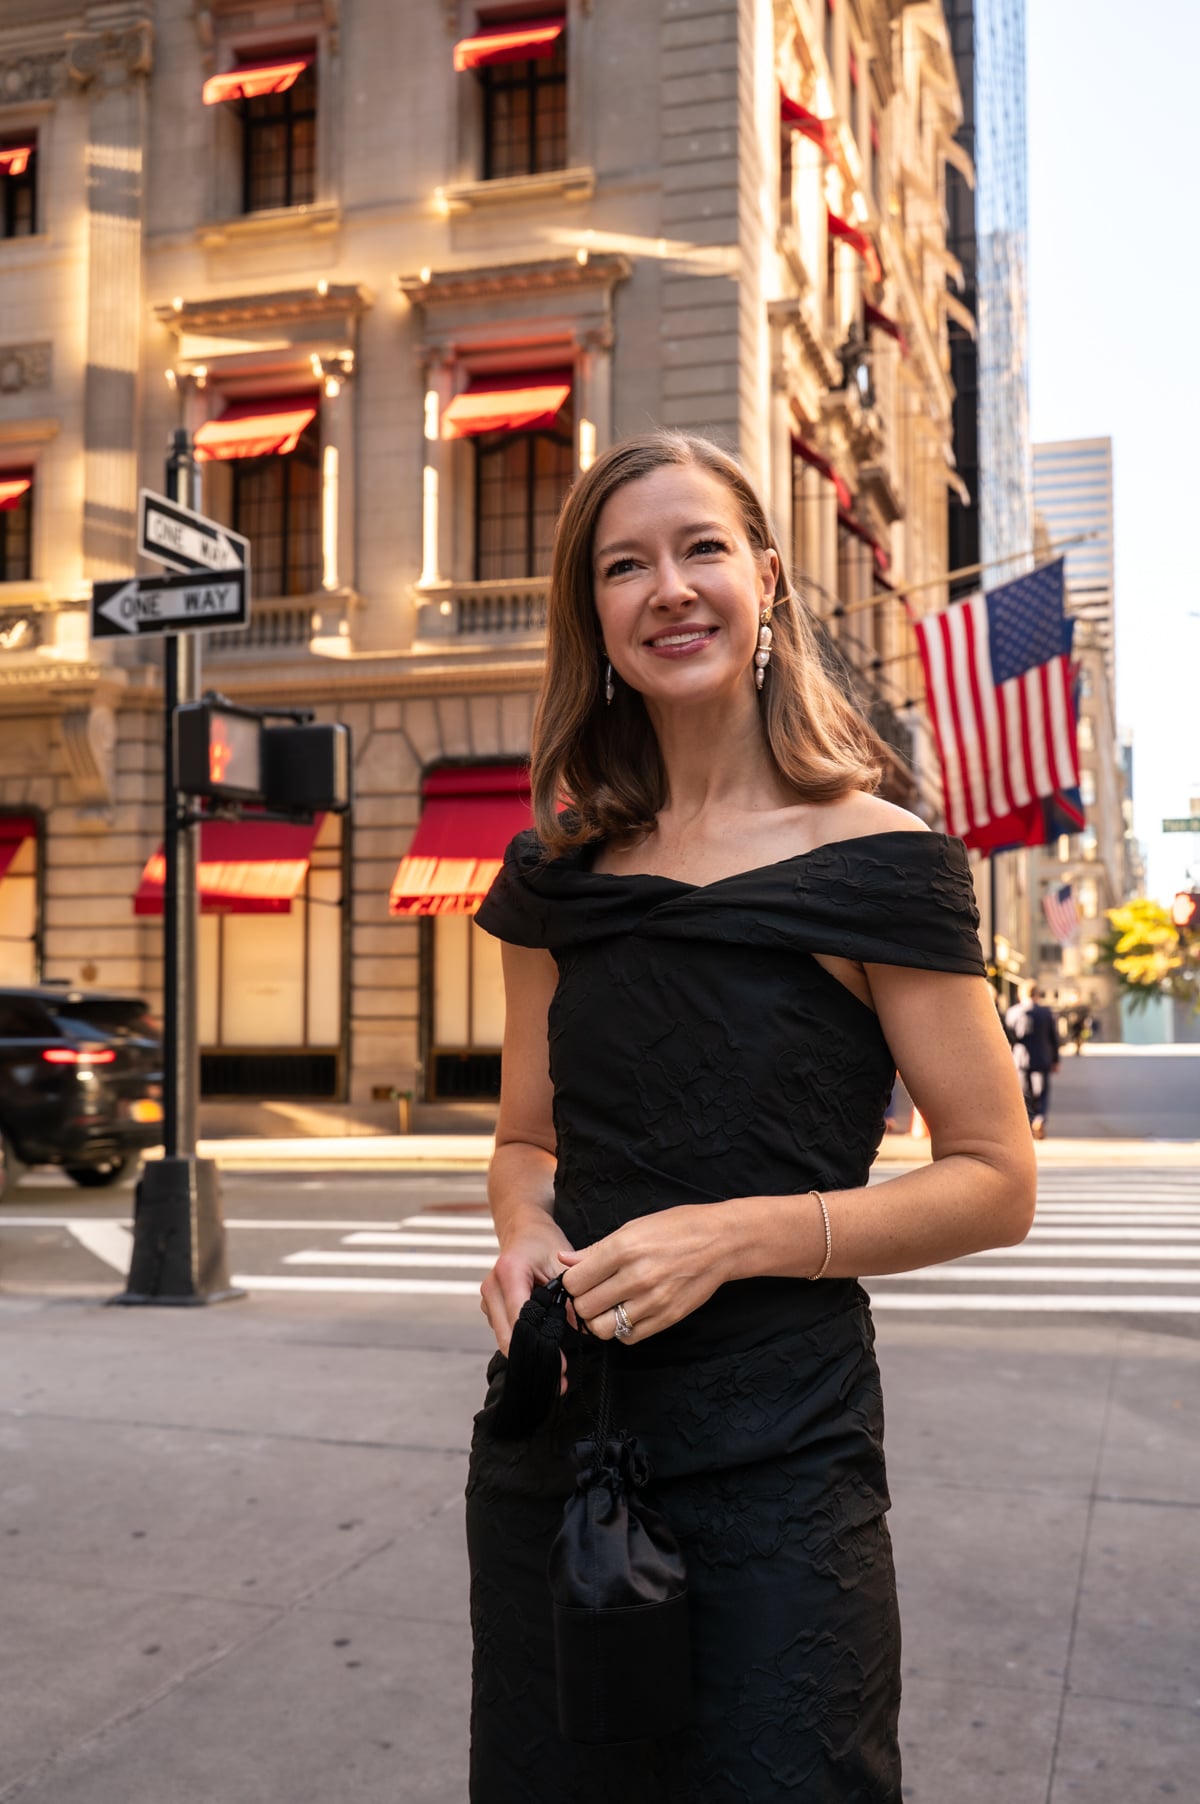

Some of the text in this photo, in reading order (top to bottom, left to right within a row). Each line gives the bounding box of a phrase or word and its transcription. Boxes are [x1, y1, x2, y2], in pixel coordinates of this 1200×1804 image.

[154, 516, 184, 550] ONE
[120, 588, 229, 620] ONE WAY
